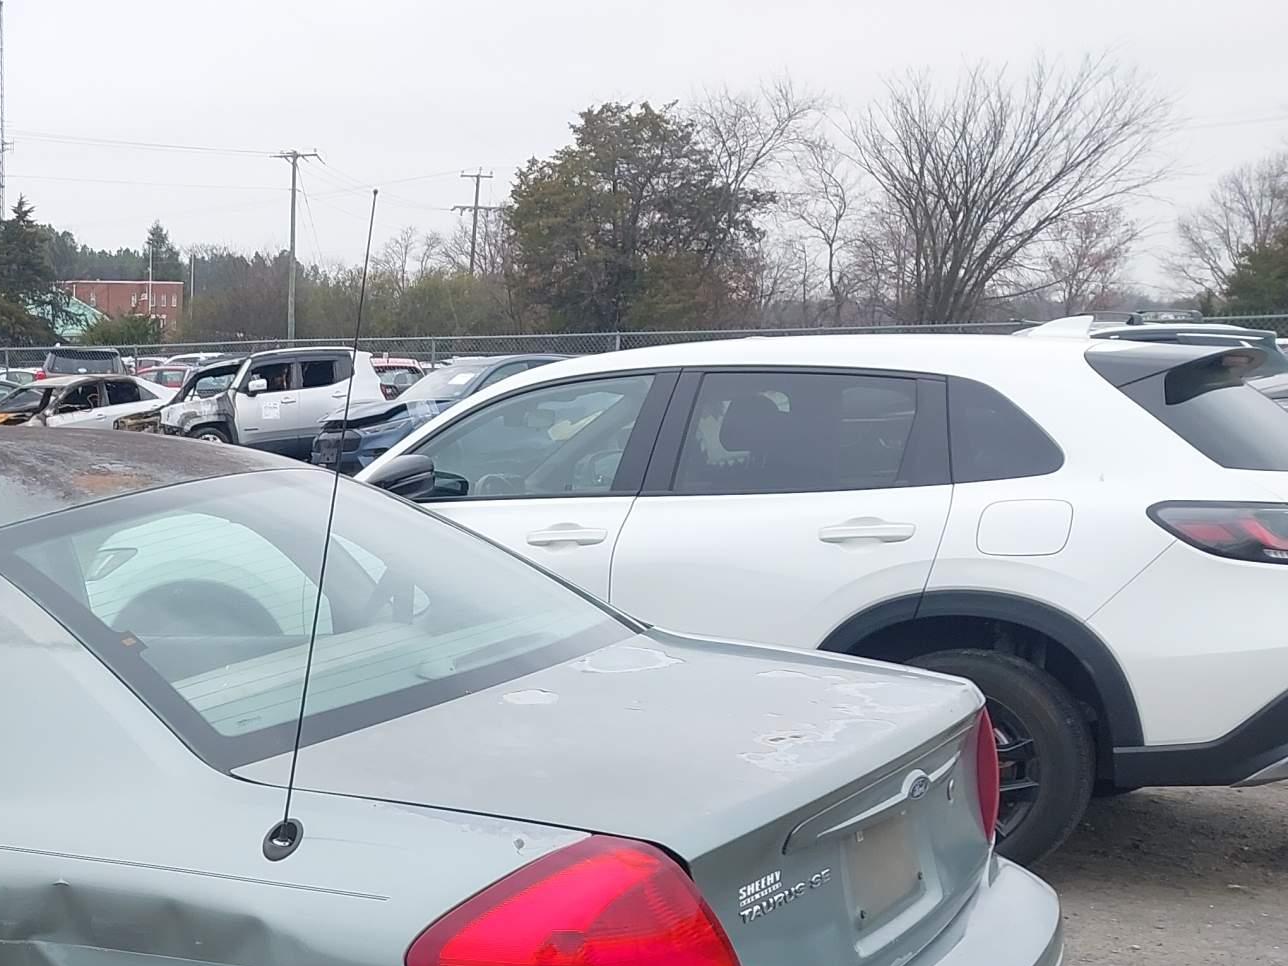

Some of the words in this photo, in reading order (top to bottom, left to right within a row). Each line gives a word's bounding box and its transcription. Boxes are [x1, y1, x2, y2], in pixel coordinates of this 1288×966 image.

[738, 870, 782, 900] SHEEHY
[739, 882, 806, 924] TAURUS
[809, 868, 832, 888] SE
